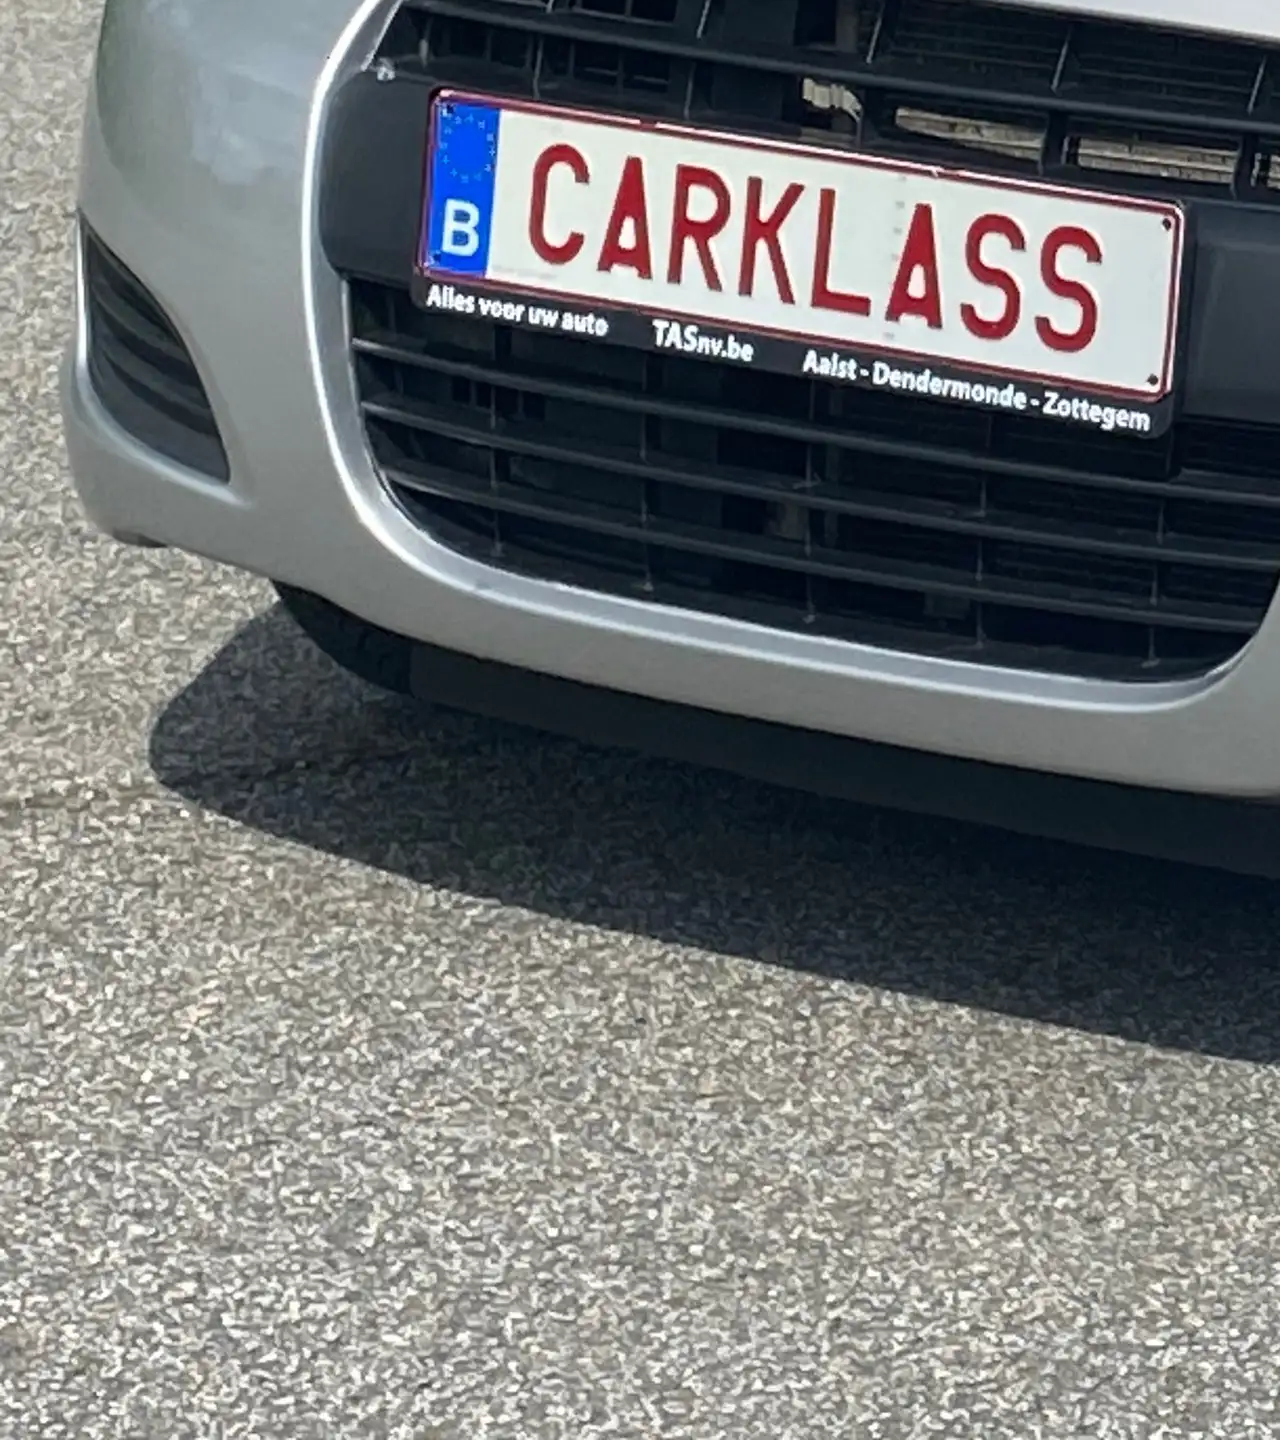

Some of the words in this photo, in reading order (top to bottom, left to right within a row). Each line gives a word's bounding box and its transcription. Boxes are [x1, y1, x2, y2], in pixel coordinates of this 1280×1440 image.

[442, 198, 480, 257] B
[528, 143, 1103, 353] CARKLASS
[426, 283, 475, 314] Alles
[478, 297, 526, 322] voor
[528, 306, 557, 329] uw
[561, 311, 609, 337] auto
[652, 318, 754, 362] TASnv.be
[802, 349, 857, 381] Aalst
[873, 361, 1028, 411] Dendermonde
[1042, 391, 1151, 432] Zottegem
